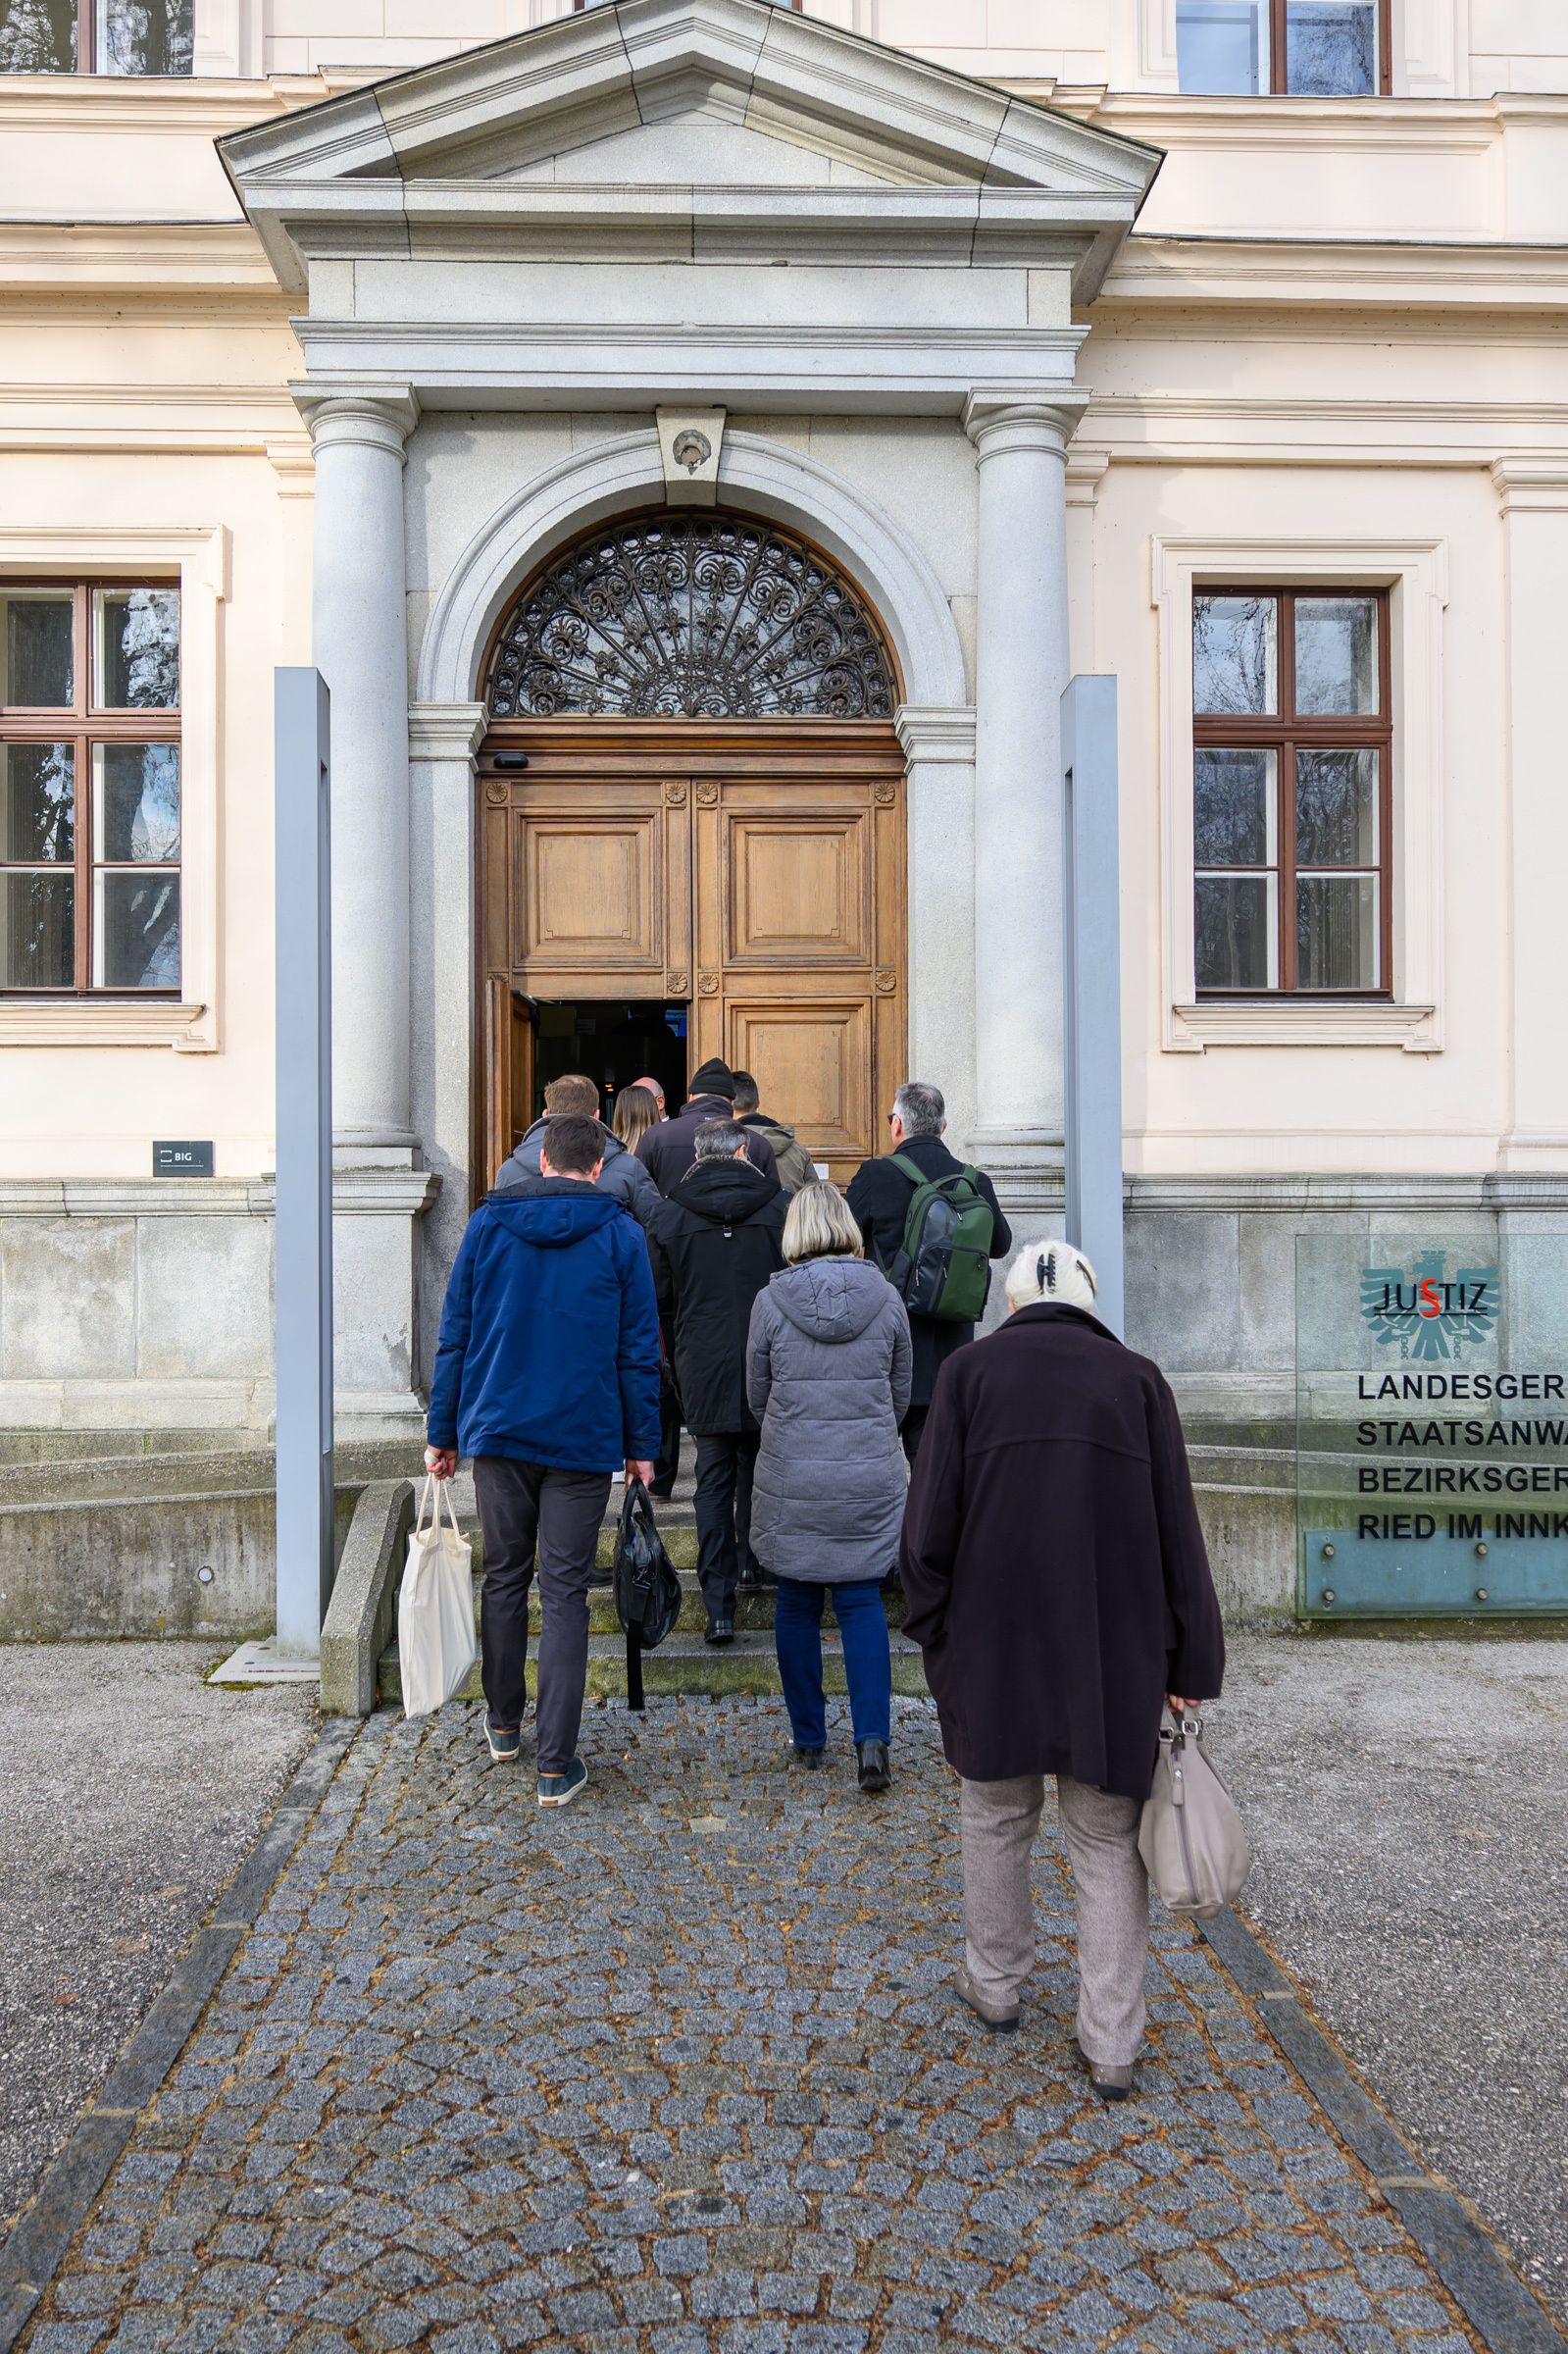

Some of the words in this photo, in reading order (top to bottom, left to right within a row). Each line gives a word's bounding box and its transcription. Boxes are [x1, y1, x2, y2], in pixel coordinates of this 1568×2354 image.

[175, 1152, 192, 1161] BIG
[1358, 1374, 1565, 1400] LANDESGER
[1356, 1420, 1568, 1446] STAATSANW
[1358, 1466, 1568, 1492] BEZIRKSGER
[1358, 1513, 1437, 1539] RIED
[1448, 1513, 1483, 1539] IM
[1495, 1513, 1568, 1539] INNK
